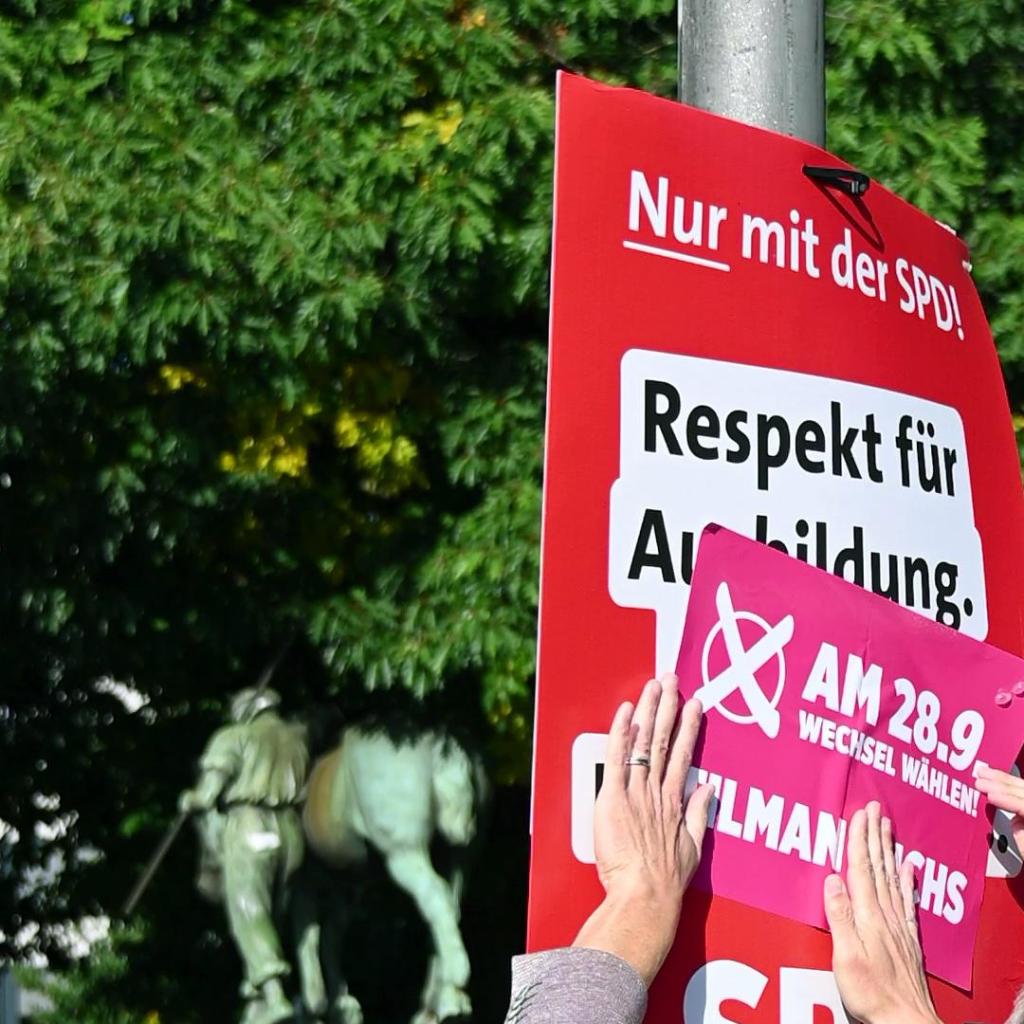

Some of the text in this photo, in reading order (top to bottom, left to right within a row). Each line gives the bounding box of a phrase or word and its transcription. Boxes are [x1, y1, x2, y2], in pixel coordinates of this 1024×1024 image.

[628, 169, 965, 341] Nur mit der SPD!
[643, 378, 957, 497] Respekt für
[801, 641, 884, 728] AM
[798, 708, 980, 818] WECHSEL WÄHLEN!
